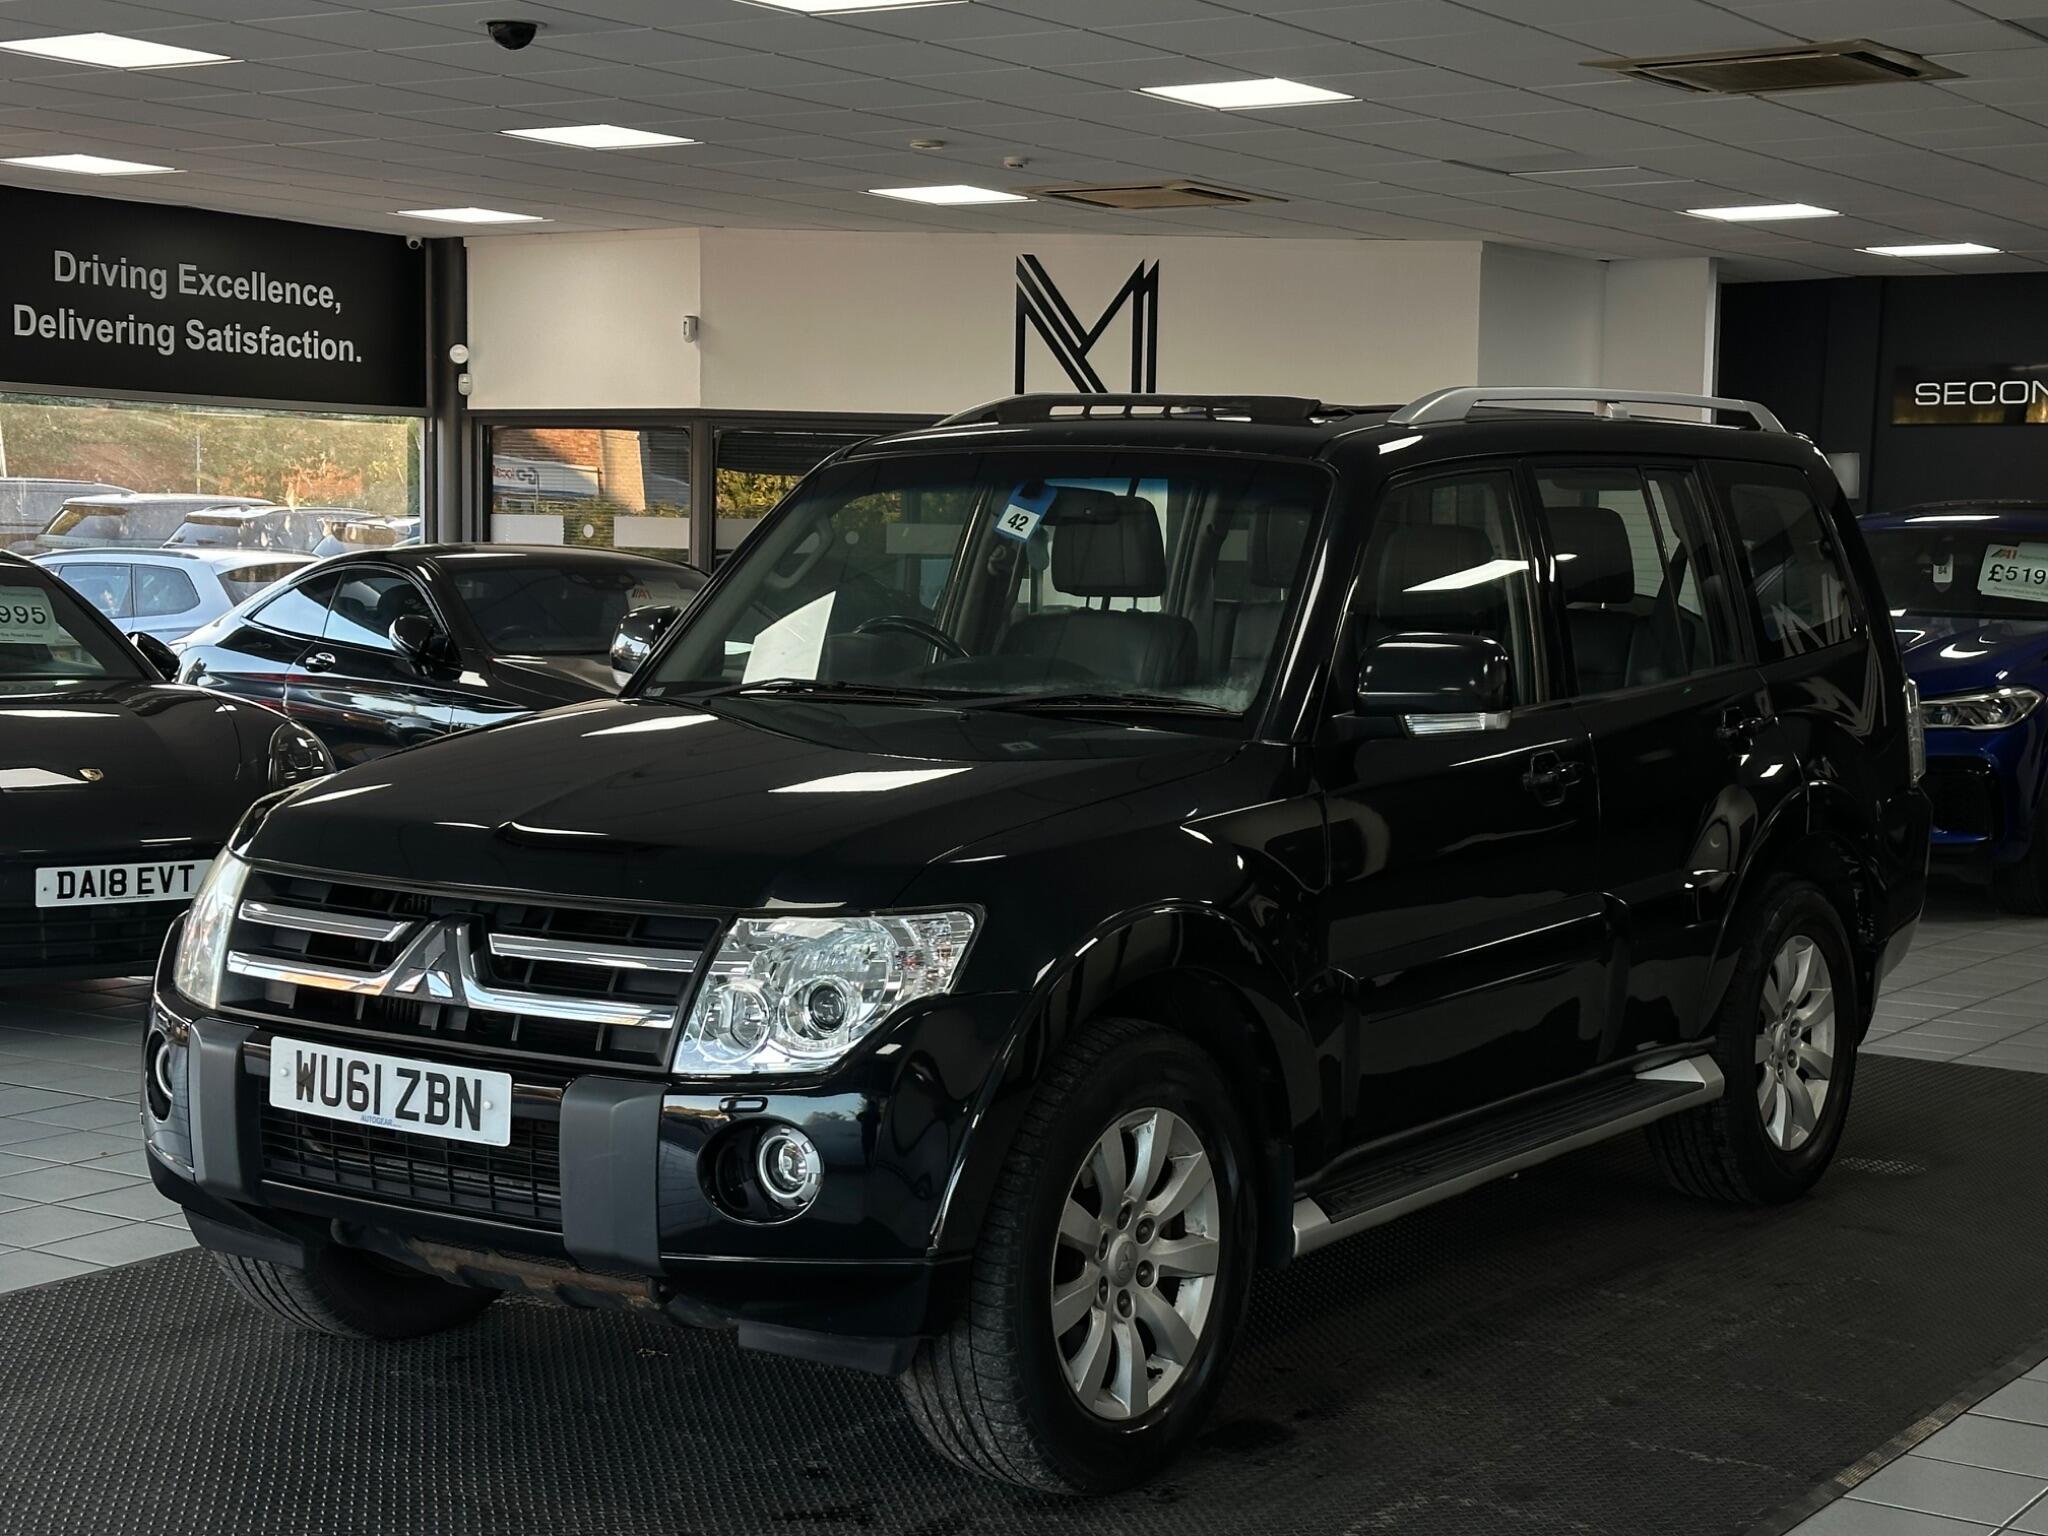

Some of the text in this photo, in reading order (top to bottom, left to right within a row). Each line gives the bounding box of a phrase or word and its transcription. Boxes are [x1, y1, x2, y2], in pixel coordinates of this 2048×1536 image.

[54, 250, 342, 314] Driving Excellence,
[13, 304, 363, 363] Delivering Satisfaction.
[1007, 513, 1029, 532] 42
[56, 864, 195, 899] DA18 EVT
[295, 1049, 482, 1132] WU61 ZBN
